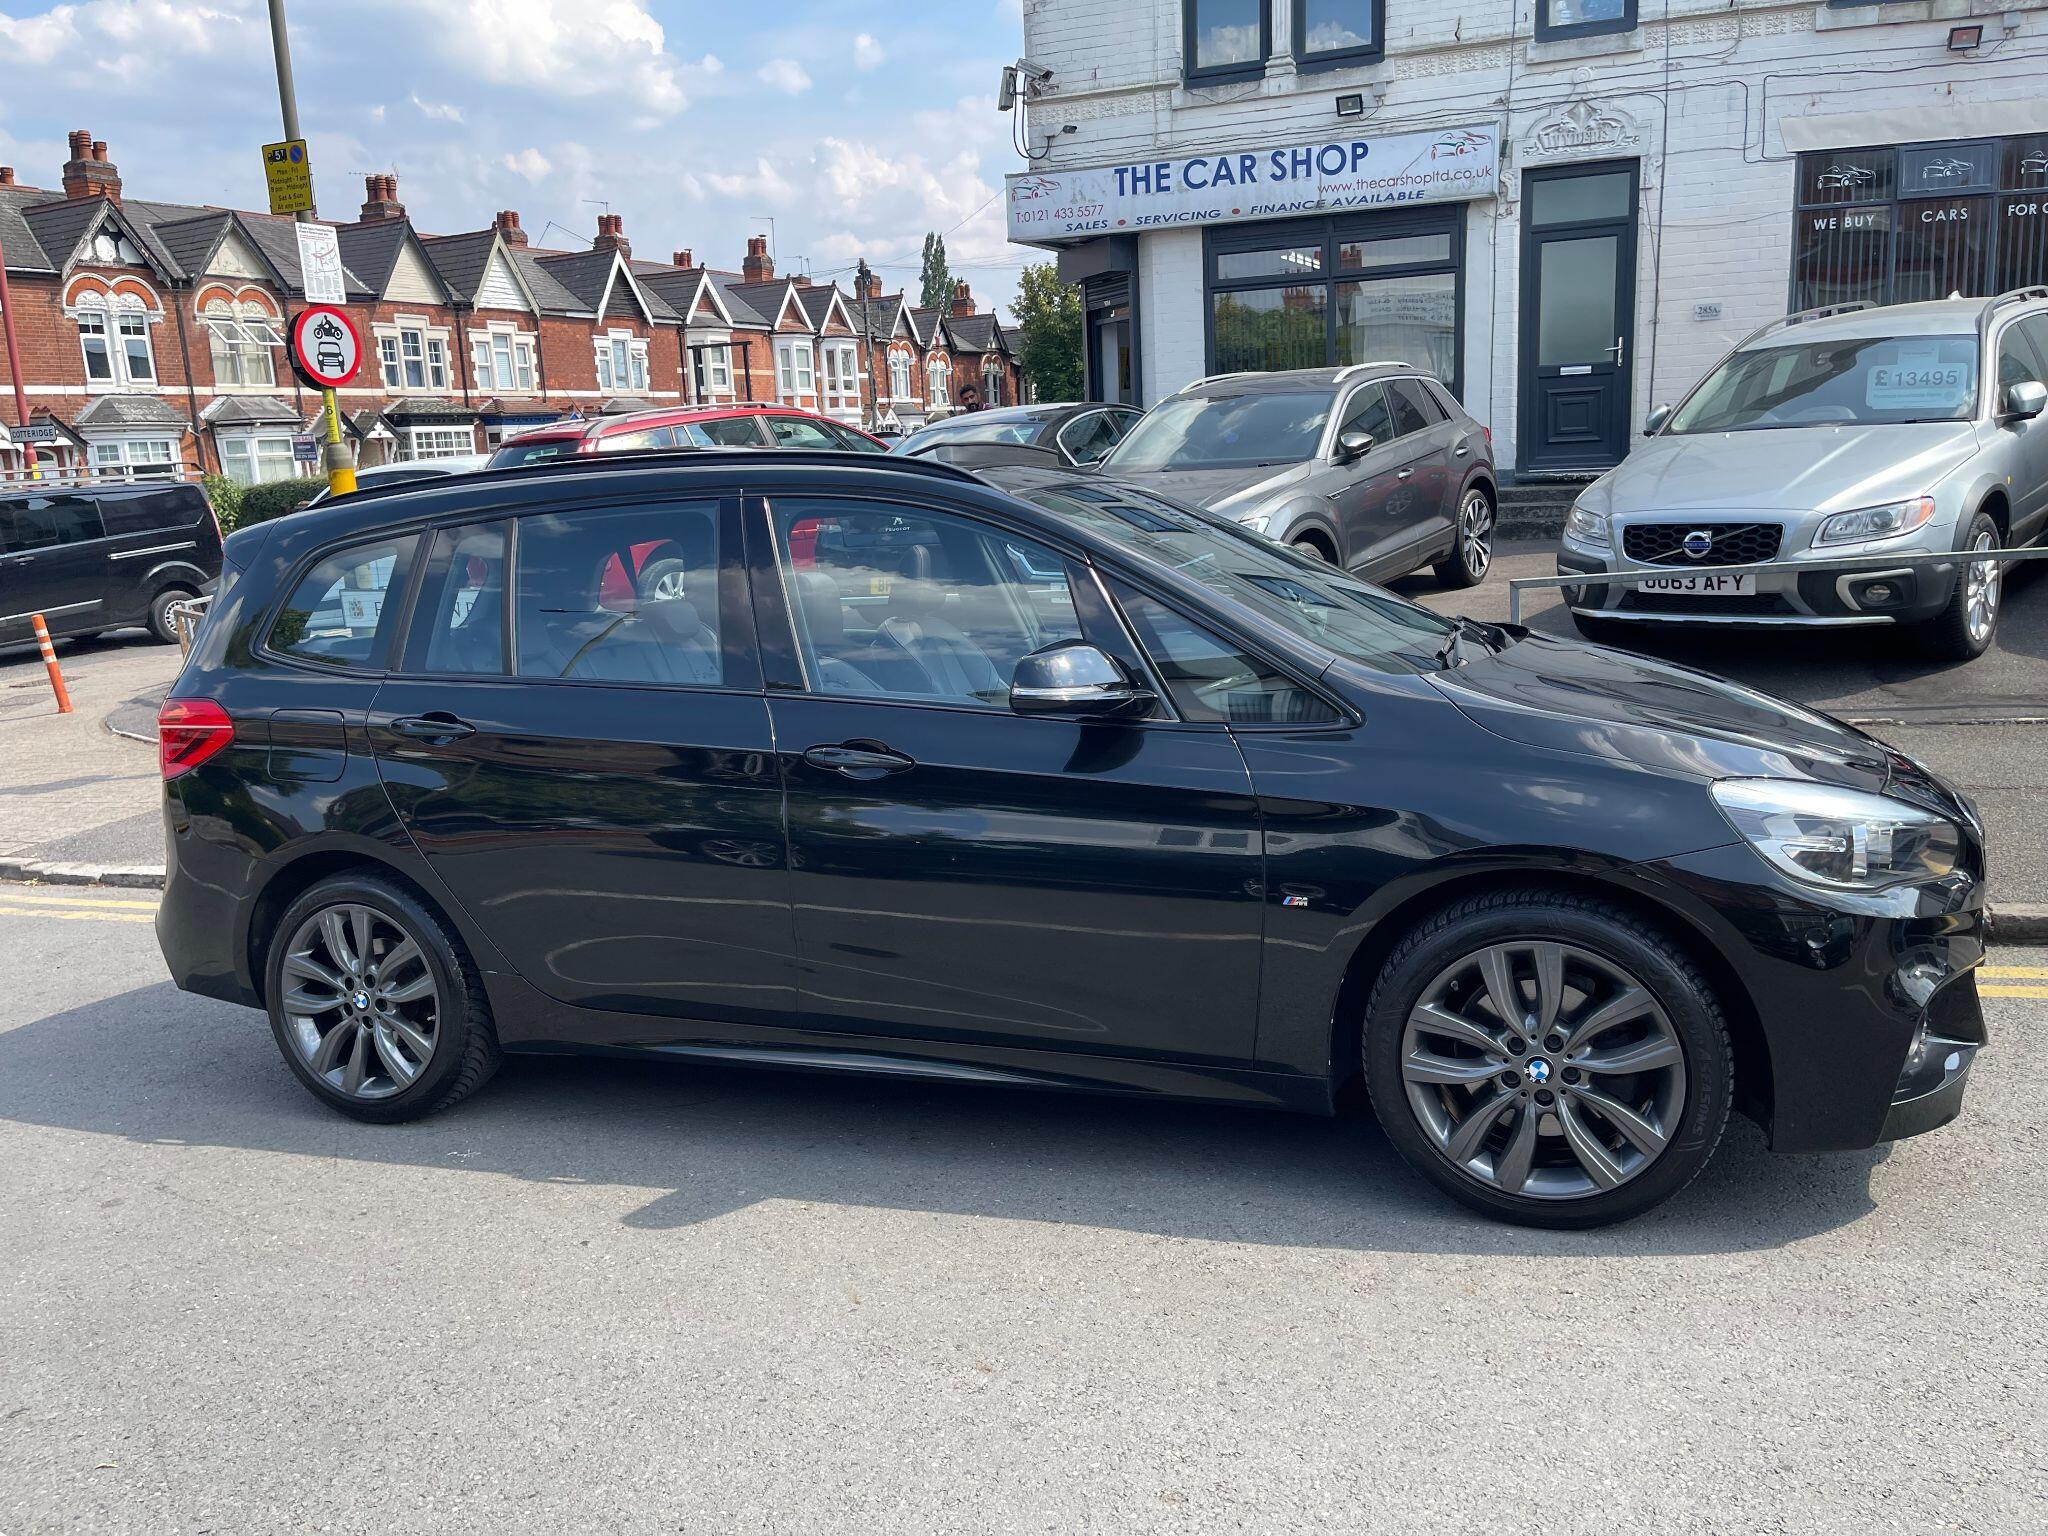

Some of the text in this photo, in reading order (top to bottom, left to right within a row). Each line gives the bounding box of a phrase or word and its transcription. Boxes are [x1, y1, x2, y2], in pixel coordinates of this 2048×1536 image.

[1114, 142, 1368, 196] THE CAR SHOP
[1317, 165, 1492, 193] www.thecarshopltd.co.uk
[1054, 207, 1074, 219] 433
[1077, 204, 1104, 218] 5577
[1065, 189, 1426, 232] SALES SERVICING FINANCE AVAILABLE
[1814, 217, 1836, 230] WE
[1844, 215, 1875, 228] BUY
[1921, 207, 1968, 223] CARS
[2007, 203, 2038, 217] FOR
